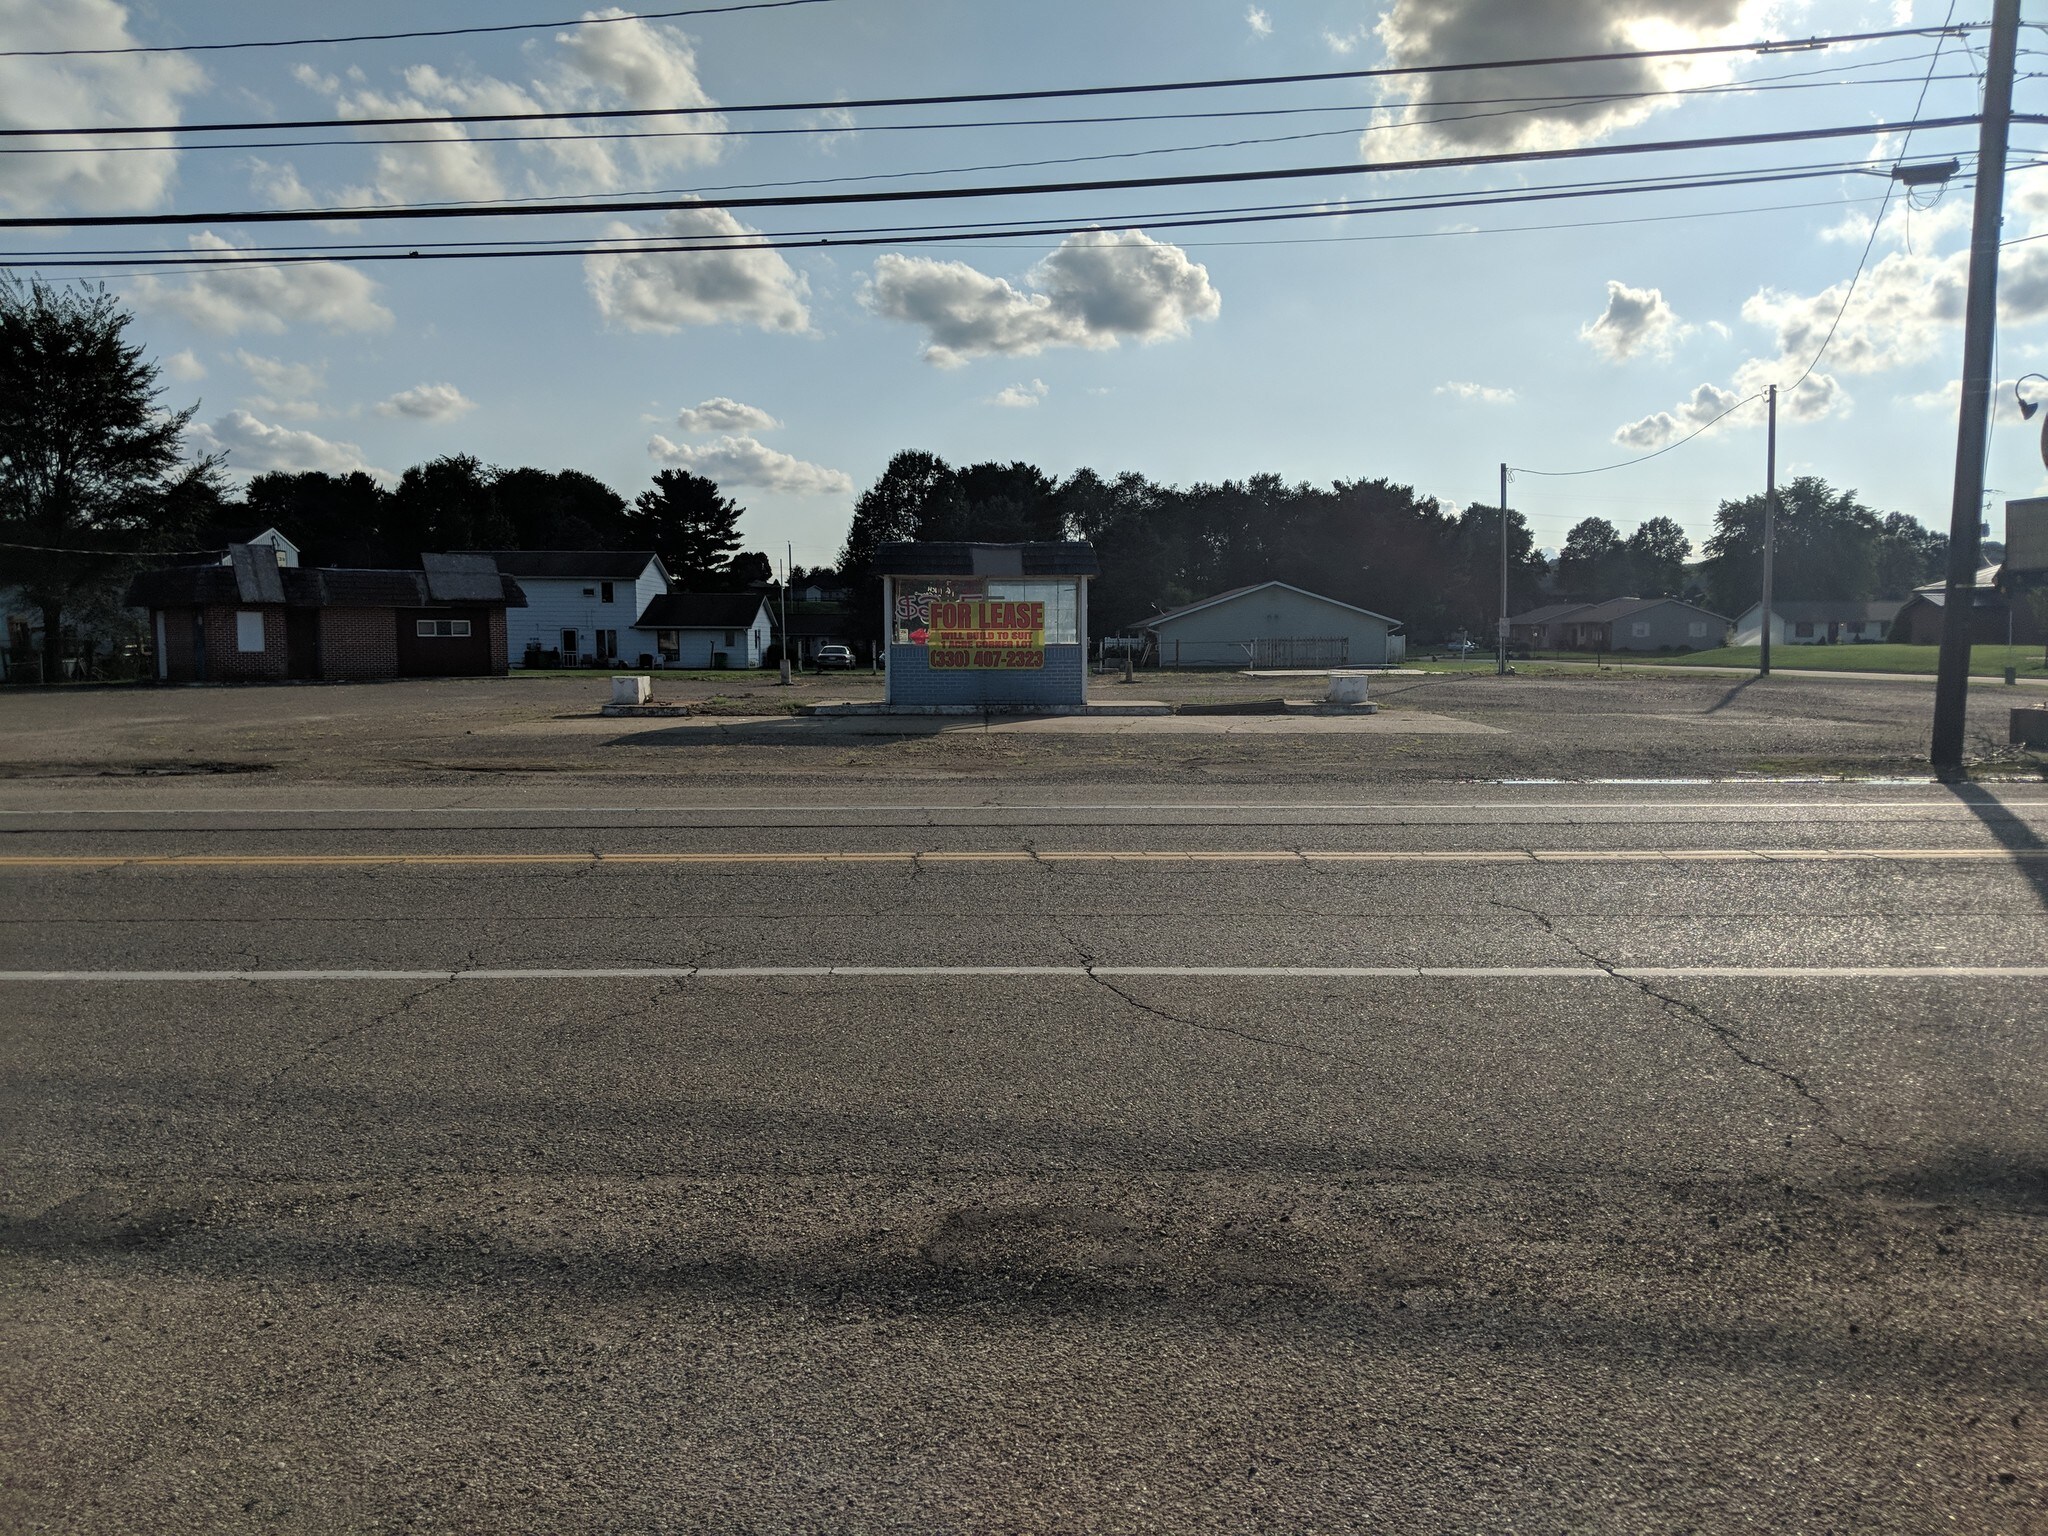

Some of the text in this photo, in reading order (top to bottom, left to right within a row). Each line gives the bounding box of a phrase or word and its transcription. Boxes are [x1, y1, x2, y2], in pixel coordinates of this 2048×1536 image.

[931, 603, 971, 628] FOR
[980, 603, 1043, 628] LEASE
[941, 632, 1033, 640] WILL BUILD TO SUIT
[947, 640, 973, 648] ACRE
[976, 640, 1013, 648] CORNER
[1016, 640, 1033, 648] LOT
[931, 650, 1043, 667] (330) 407-2323
